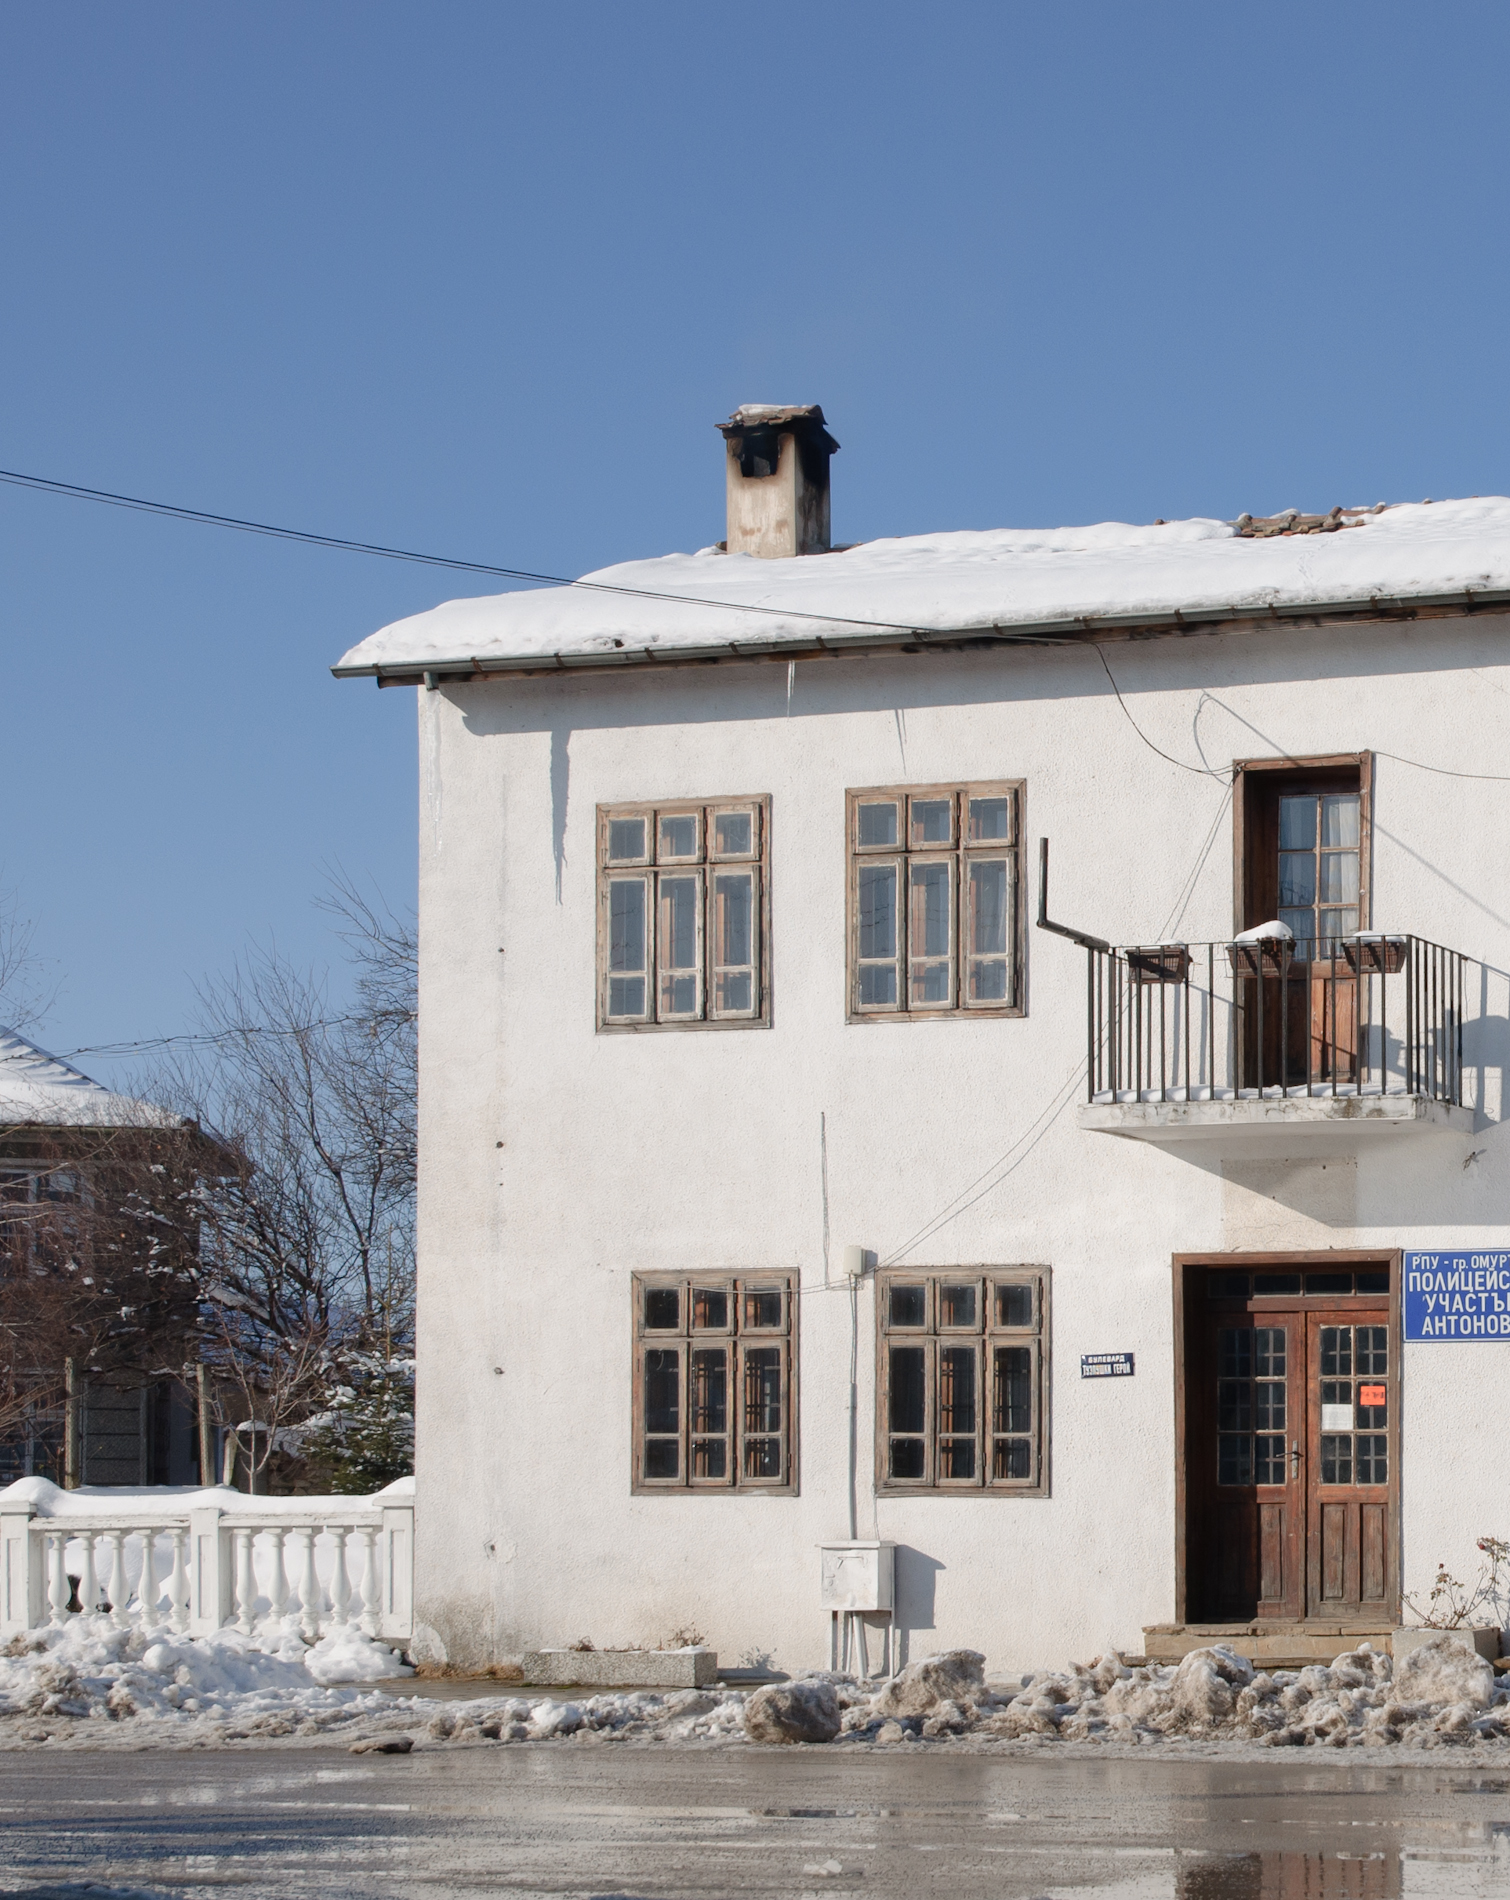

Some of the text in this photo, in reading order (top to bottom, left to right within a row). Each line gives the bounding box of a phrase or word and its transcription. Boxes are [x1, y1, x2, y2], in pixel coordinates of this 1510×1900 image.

[1412, 1255, 1439, 1270] РПУ
[1453, 1258, 1469, 1272] гр.
[1088, 1355, 1125, 1363] БУЛЕВАРД
